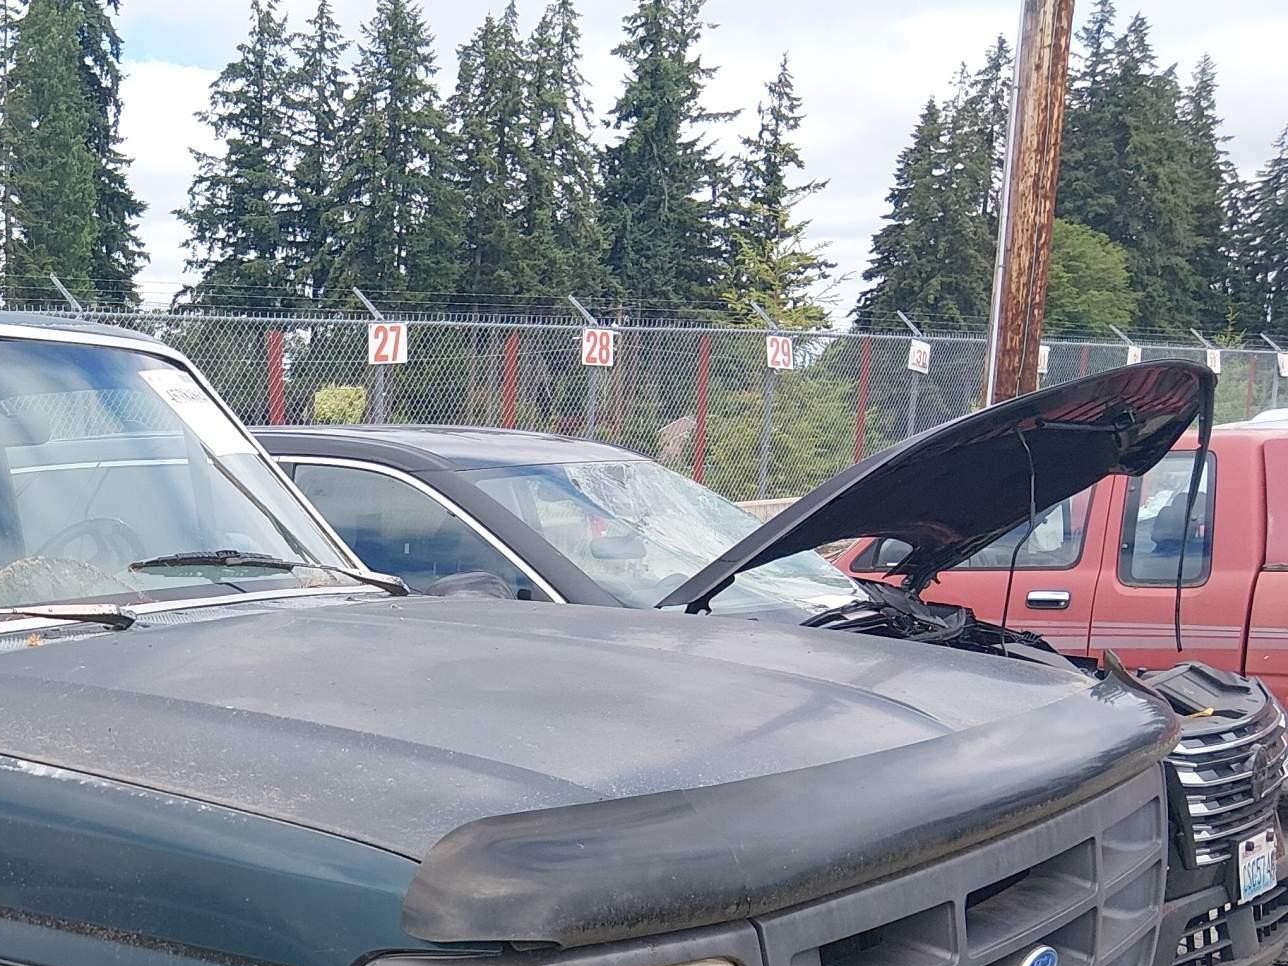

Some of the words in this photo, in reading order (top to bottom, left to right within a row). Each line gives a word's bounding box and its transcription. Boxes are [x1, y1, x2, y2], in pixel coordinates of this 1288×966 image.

[374, 325, 402, 362] 27
[585, 331, 610, 365] 28
[770, 337, 791, 368] 29
